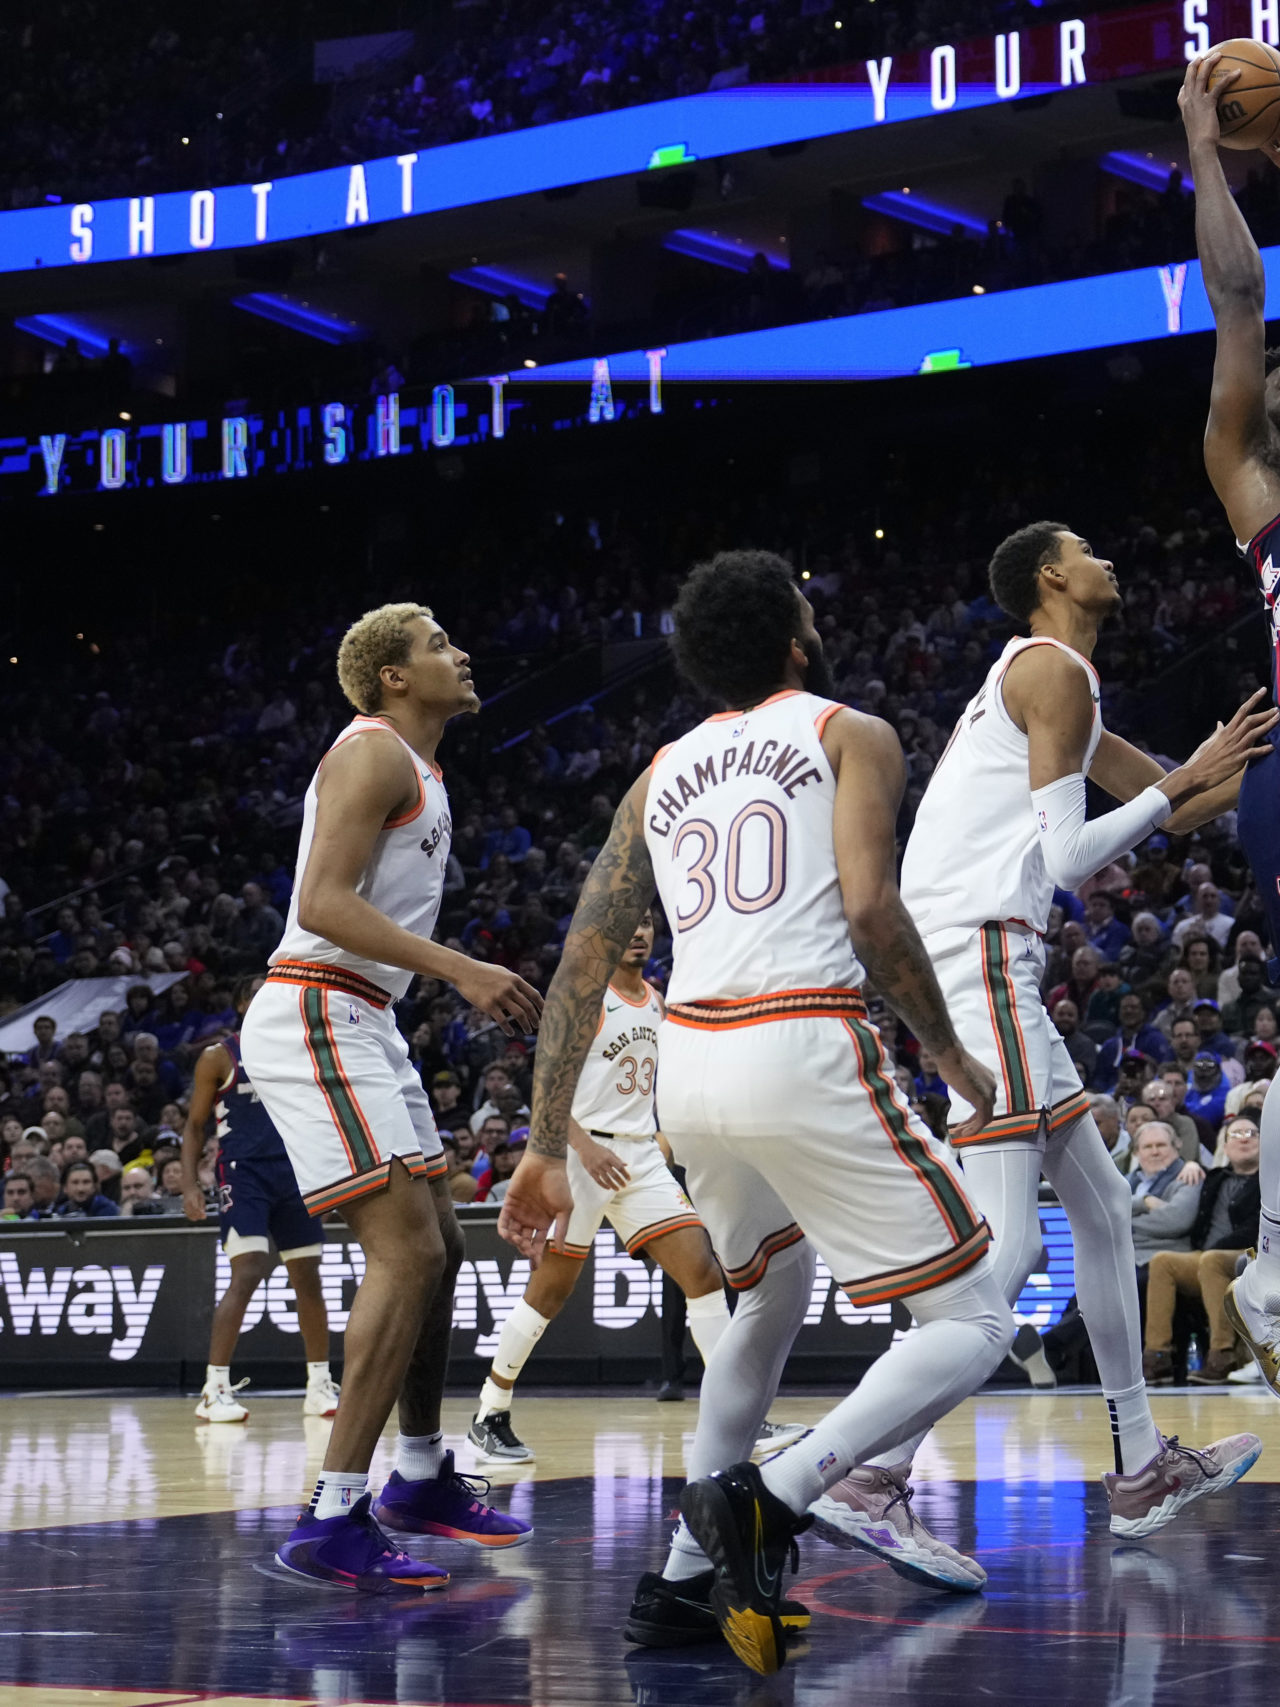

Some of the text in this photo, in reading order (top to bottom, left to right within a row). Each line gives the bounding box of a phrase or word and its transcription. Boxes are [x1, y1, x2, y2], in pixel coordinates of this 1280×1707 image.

[866, 20, 1086, 122] YOUR
[70, 154, 418, 262] SHOT AT
[40, 348, 668, 494] YOUR SHOT AT
[650, 739, 823, 838] CHAMPAGNIE
[671, 799, 788, 934] 30
[602, 1032, 631, 1061] SAN
[616, 1056, 655, 1096] 33
[0, 1252, 165, 1361] way
